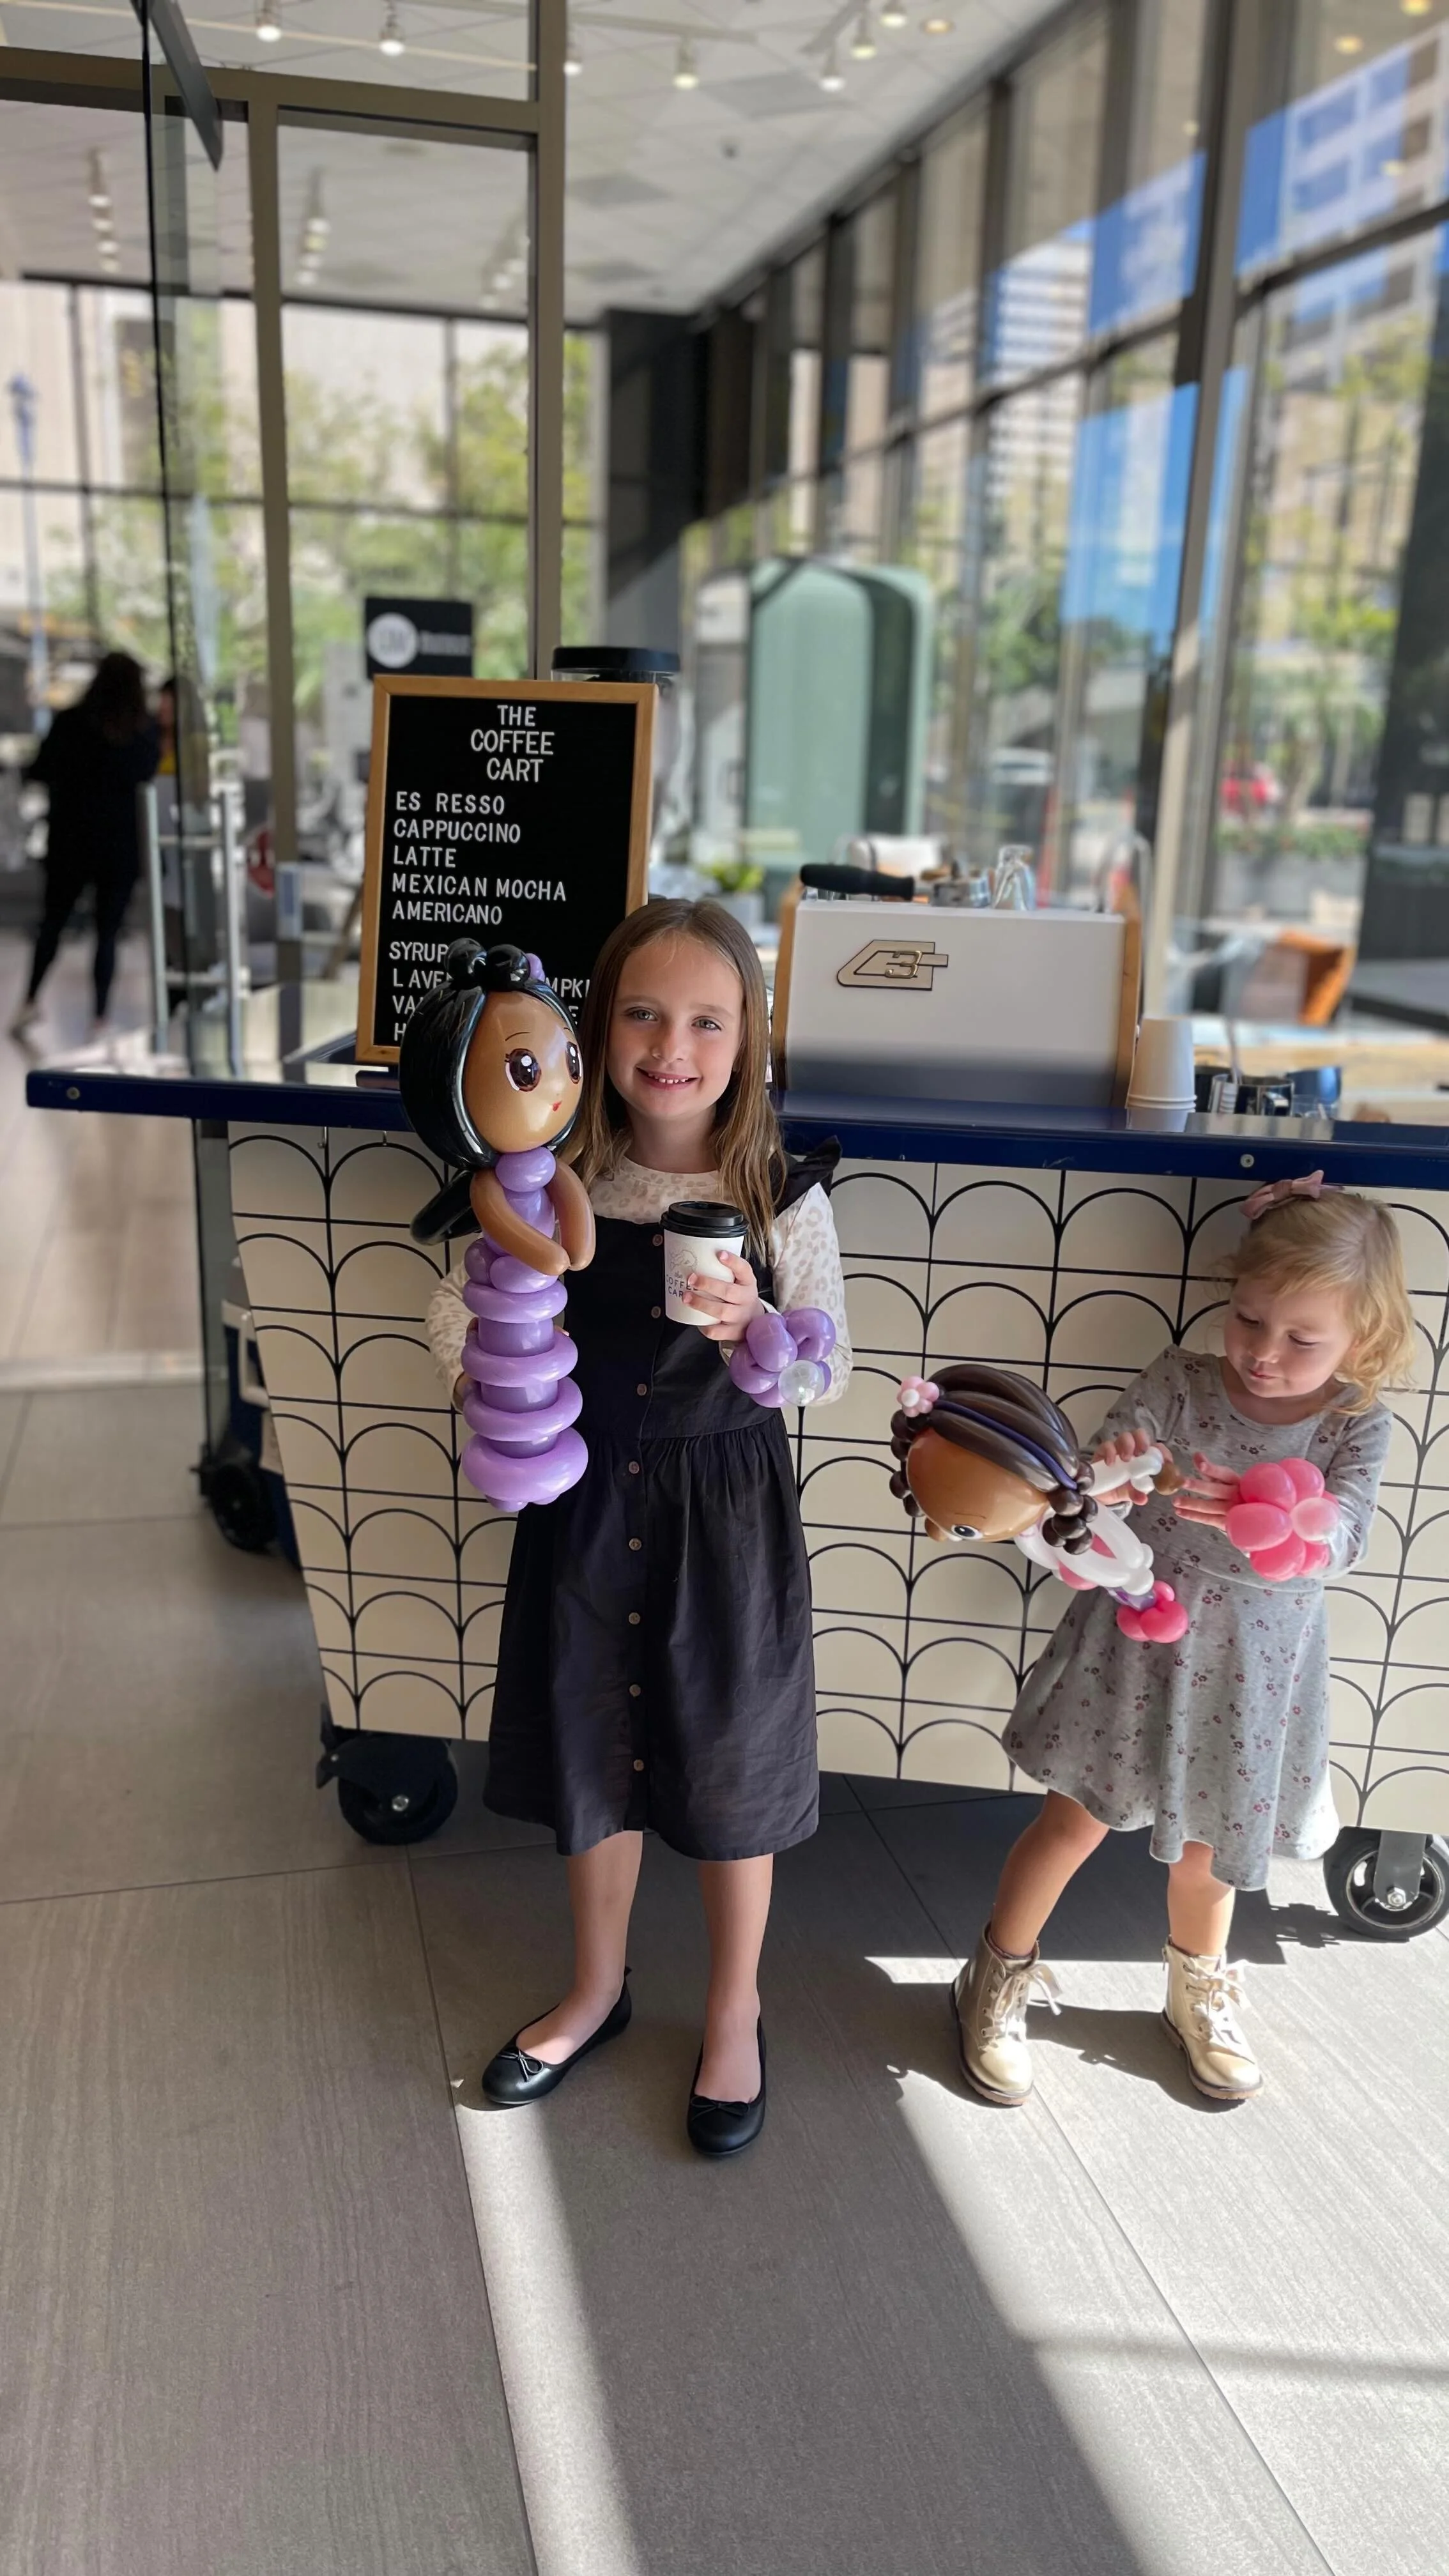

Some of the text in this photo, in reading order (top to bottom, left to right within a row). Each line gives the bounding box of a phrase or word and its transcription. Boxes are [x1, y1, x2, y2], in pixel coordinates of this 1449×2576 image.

[497, 705, 536, 726] THE
[470, 728, 555, 755] COFFEE
[486, 757, 544, 783] CART
[394, 818, 521, 843] CAPPUCCINO
[393, 845, 457, 868] LATTE
[392, 873, 566, 901] MEXICAN MOCHA
[392, 900, 502, 925] AMERICANO
[668, 1285, 684, 1297] CAR
